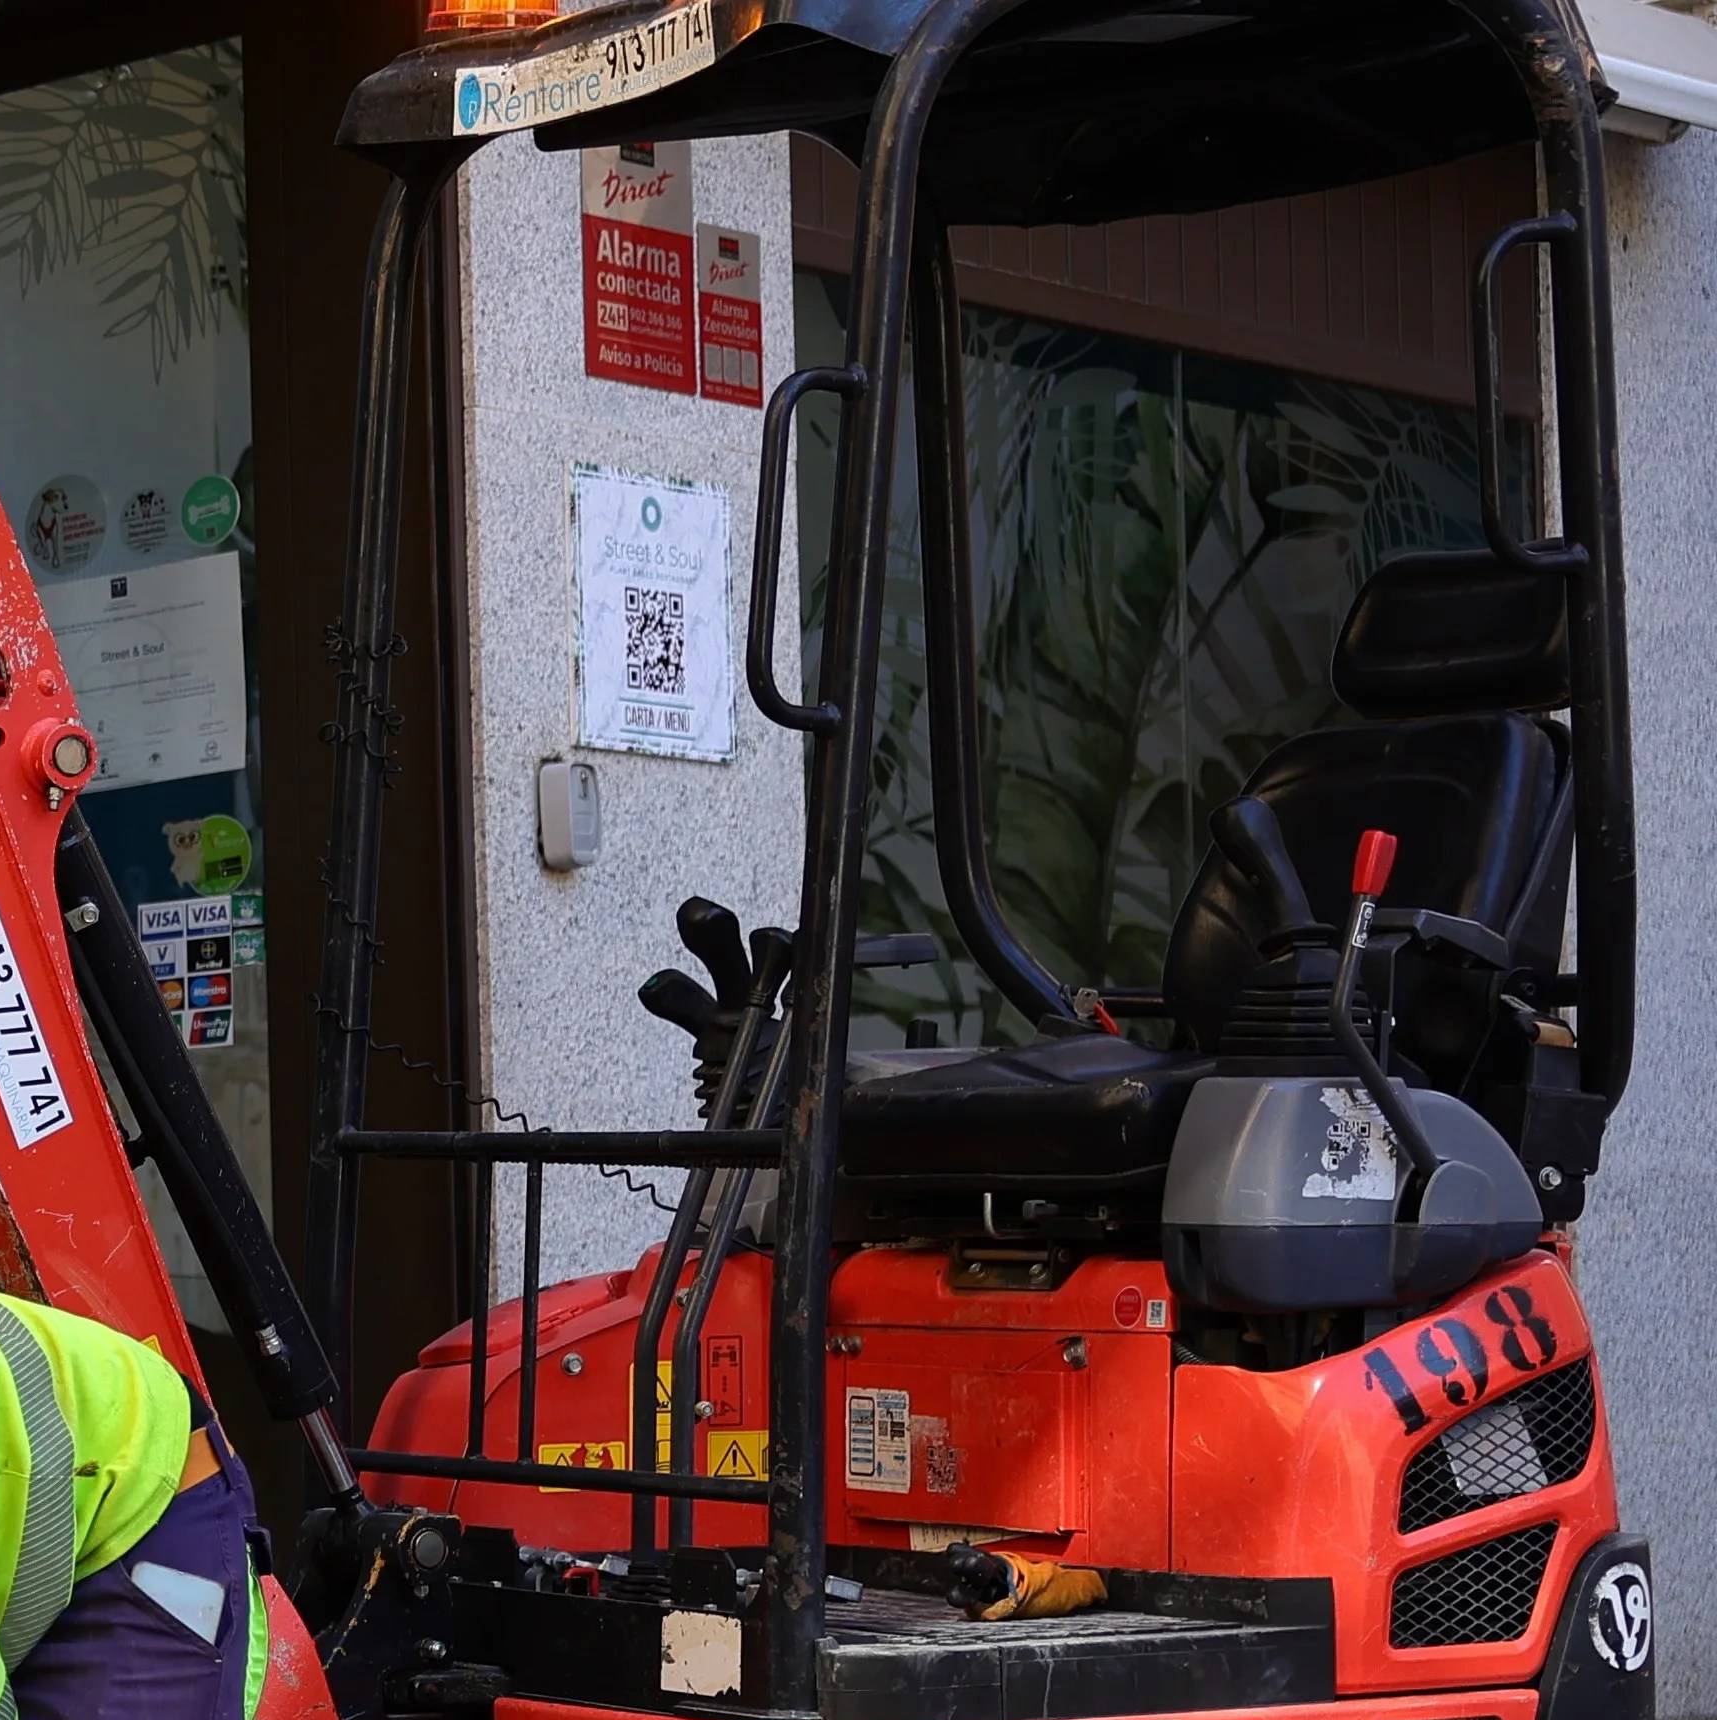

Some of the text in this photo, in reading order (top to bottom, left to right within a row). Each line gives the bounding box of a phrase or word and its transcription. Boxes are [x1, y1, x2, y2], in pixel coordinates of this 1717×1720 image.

[606, 2, 712, 80] 913 777 741
[609, 47, 714, 98] ALQUILER DE MAQUINARIA
[482, 71, 601, 126] Rentaire
[602, 168, 674, 209] Direct
[597, 228, 681, 278] Alarma
[709, 261, 750, 285] Direct
[597, 270, 682, 306] conectada
[599, 303, 628, 328] 24H
[711, 299, 750, 320] Alarma
[599, 343, 632, 367] Aviso
[634, 352, 643, 368] a
[603, 535, 703, 571] Street & Soul
[100, 642, 165, 663] Street & Soul
[625, 705, 655, 730] CARTA
[145, 911, 182, 929] VISA
[191, 904, 228, 924] VISA
[157, 946, 169, 963] V
[193, 983, 227, 996] Maestro
[18, 1065, 66, 1133] 741
[1363, 1284, 1559, 1436] 198
